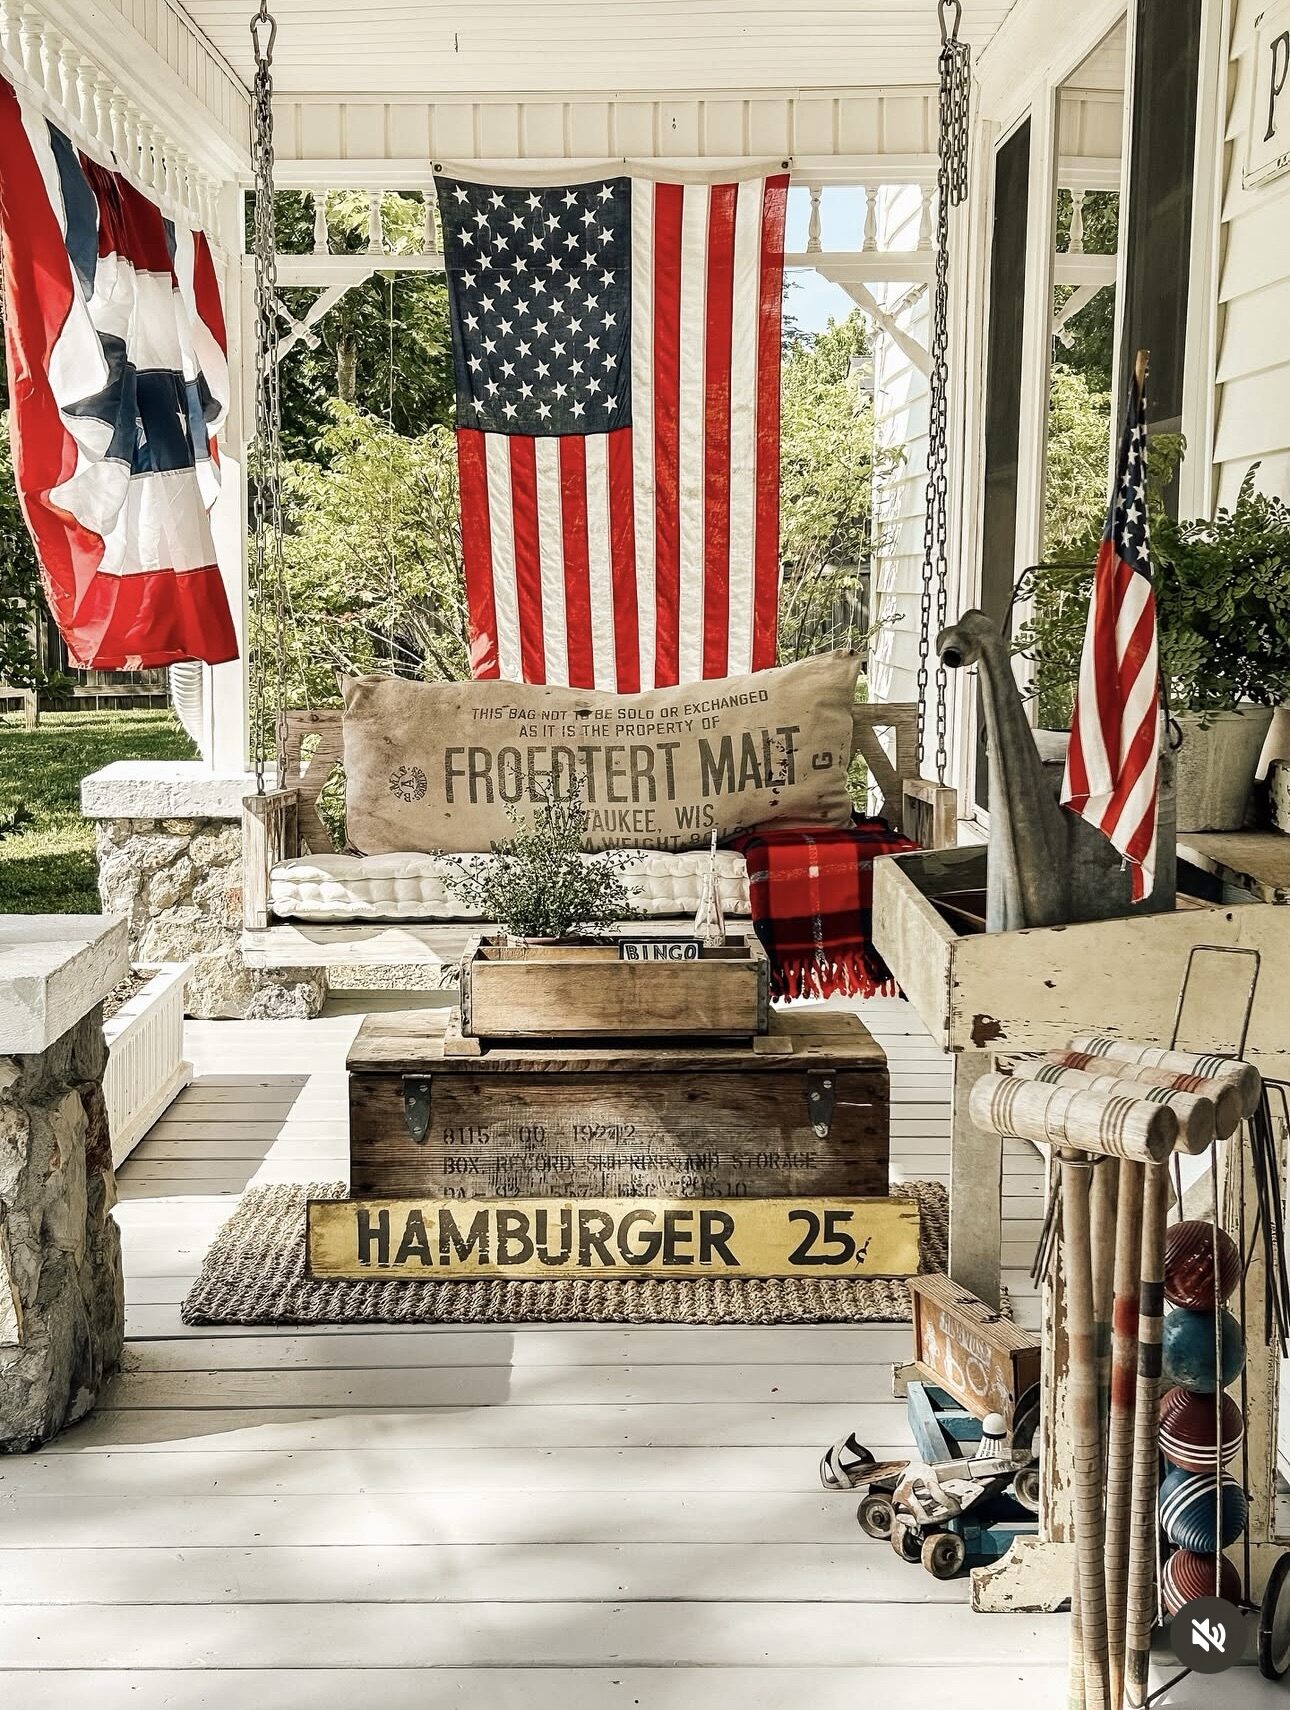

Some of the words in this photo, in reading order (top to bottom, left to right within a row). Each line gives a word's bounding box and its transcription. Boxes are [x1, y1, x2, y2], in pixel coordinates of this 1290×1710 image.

[471, 708, 503, 720] THIS
[508, 708, 536, 720] BAG
[541, 710, 568, 721] NOT
[594, 709, 613, 720] BE
[617, 708, 654, 720] SOLD
[660, 706, 679, 718] OR
[684, 689, 769, 716] EXCHANGED
[519, 724, 538, 738] AS
[543, 724, 556, 737] IT
[562, 725, 576, 737] IS
[582, 724, 610, 737] THE
[615, 719, 694, 737] PROPERTY
[702, 715, 720, 730] OF
[444, 741, 682, 804] FROEDTERT
[698, 725, 800, 797] MALT
[624, 944, 698, 961] BINGO
[443, 1126, 491, 1145] 8115
[357, 1208, 741, 1267] HAMBURGER
